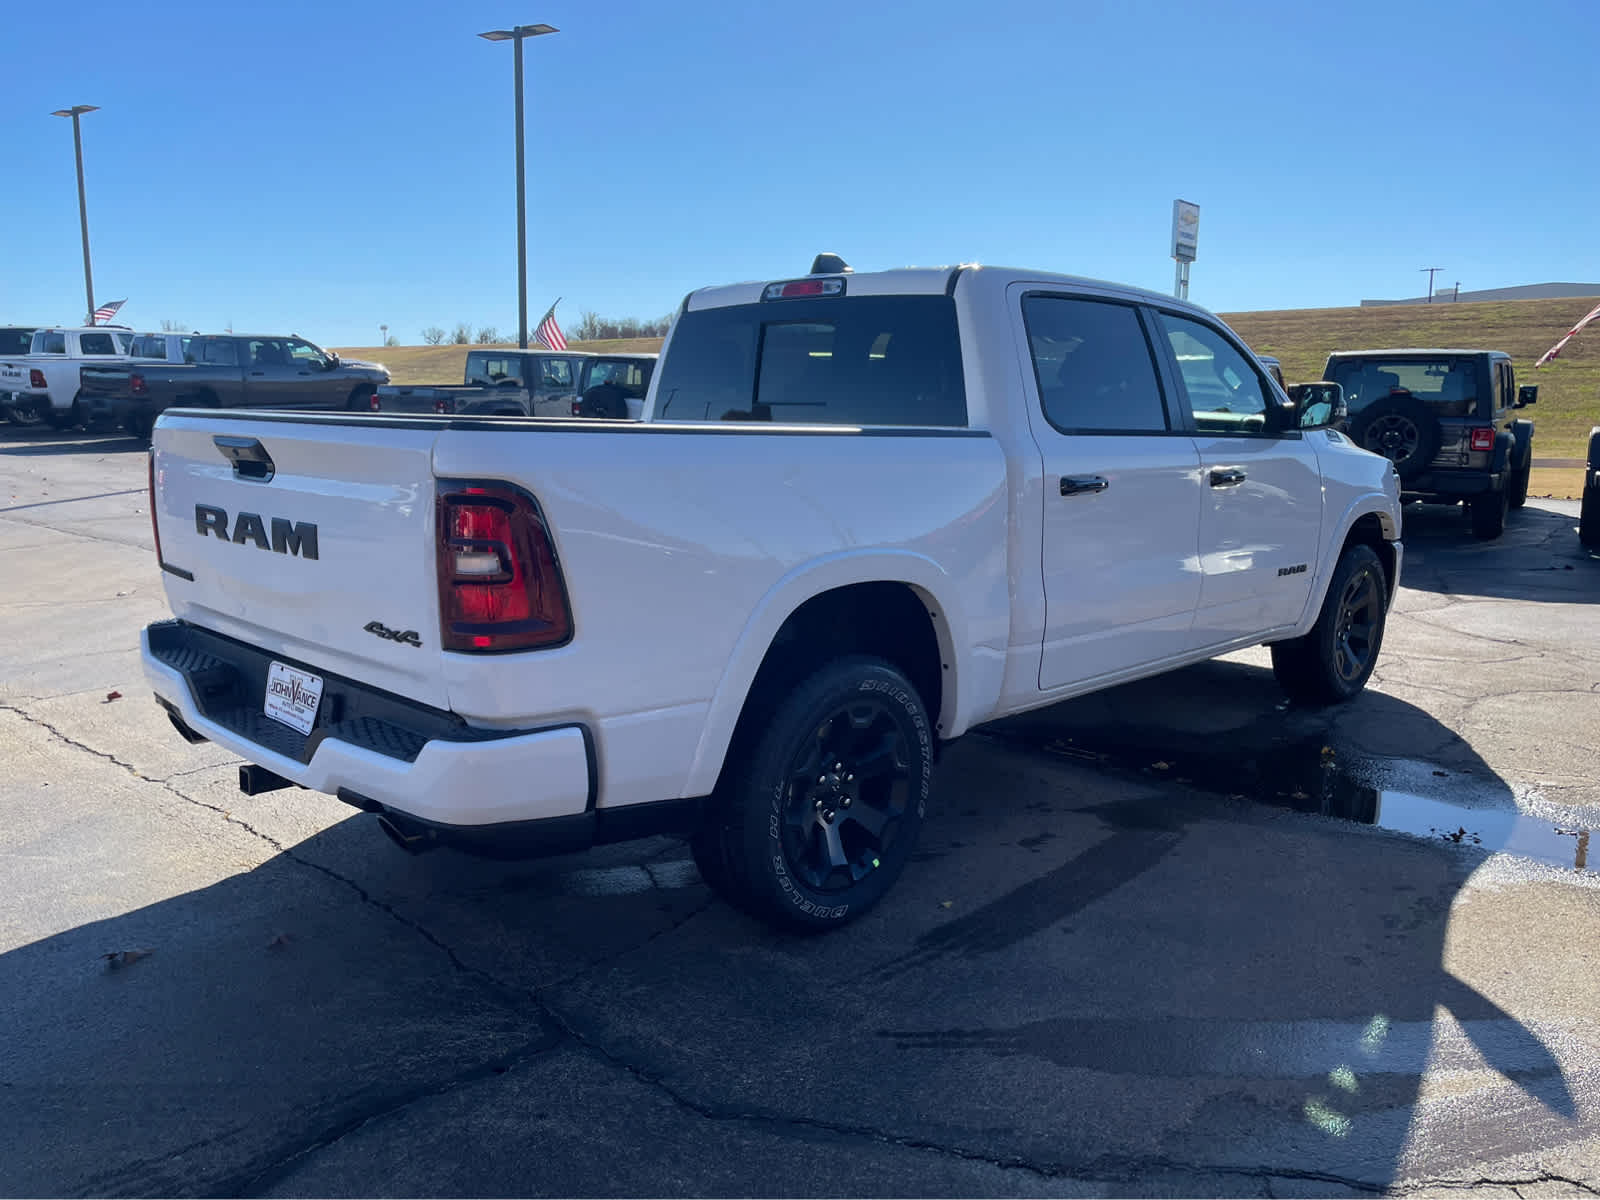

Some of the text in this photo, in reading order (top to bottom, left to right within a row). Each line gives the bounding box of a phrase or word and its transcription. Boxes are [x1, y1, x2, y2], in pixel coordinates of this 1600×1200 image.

[195, 504, 319, 561] RAM
[1278, 564, 1307, 576] RAM
[271, 680, 317, 708] JOHN VANCE
